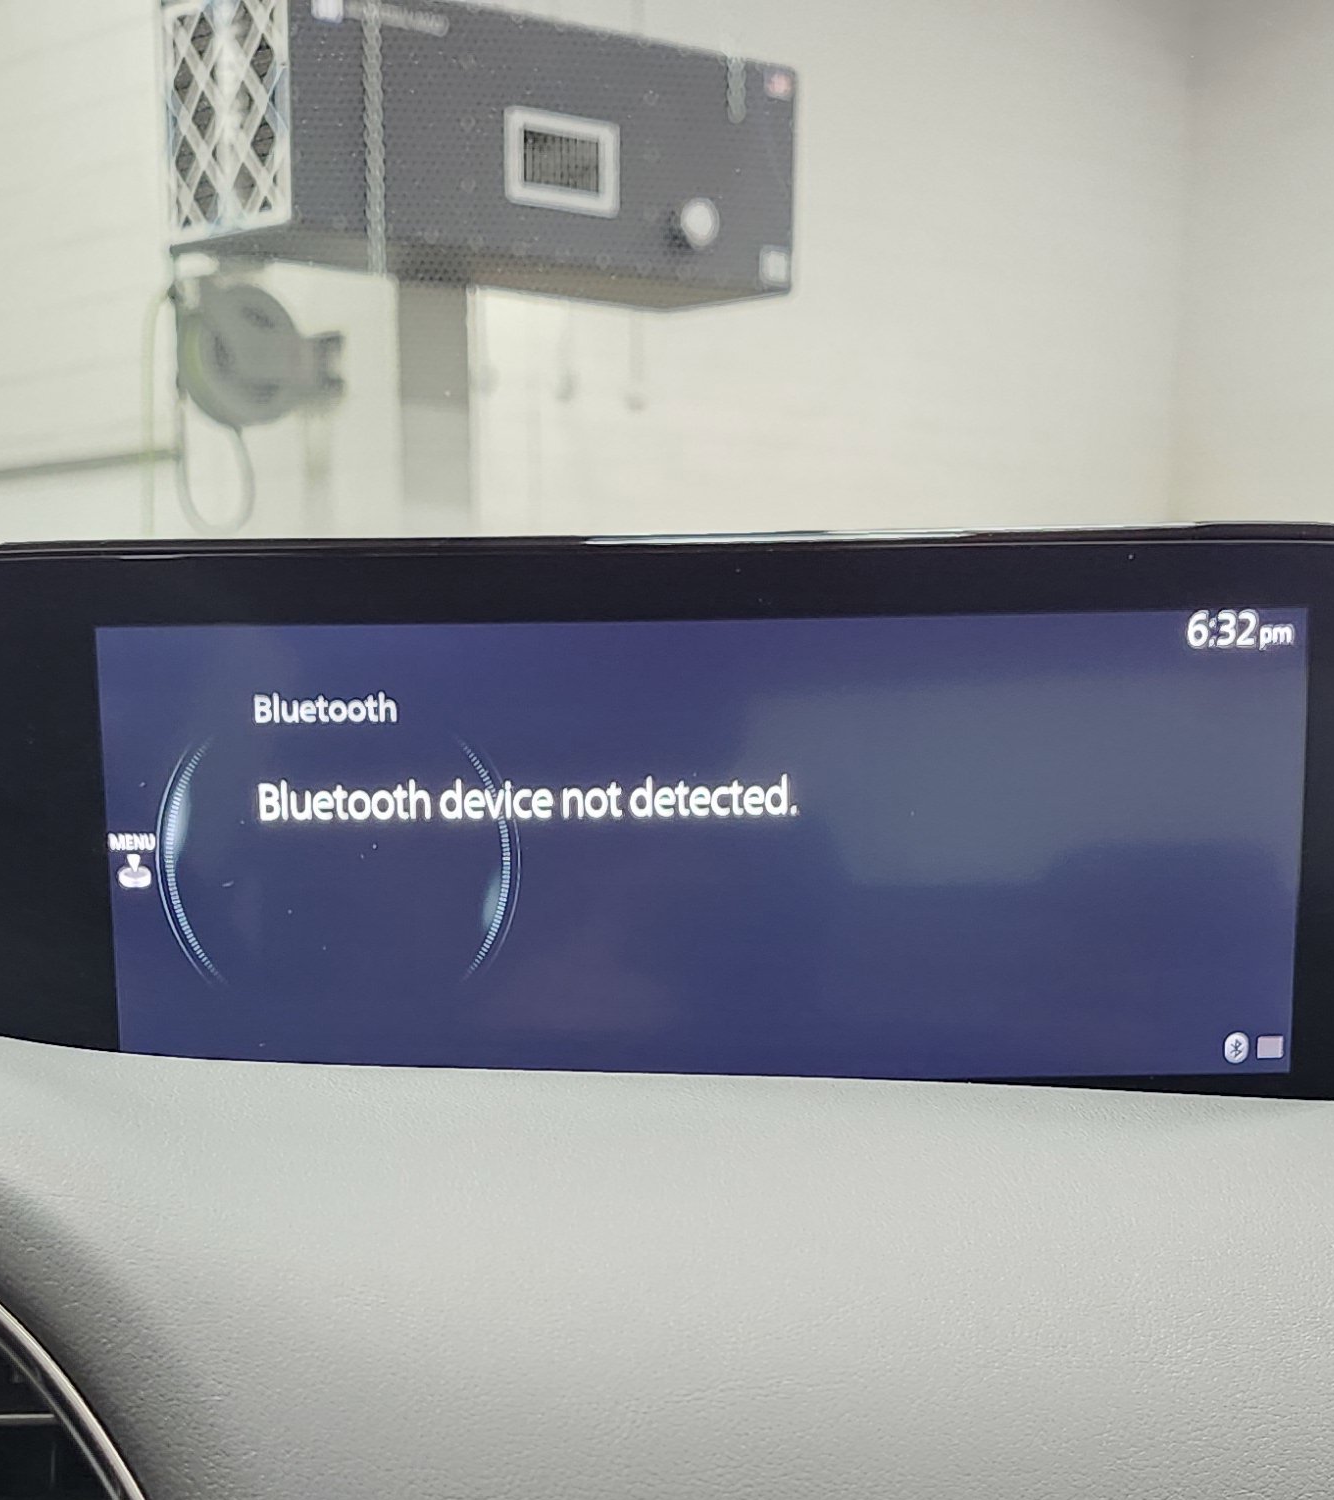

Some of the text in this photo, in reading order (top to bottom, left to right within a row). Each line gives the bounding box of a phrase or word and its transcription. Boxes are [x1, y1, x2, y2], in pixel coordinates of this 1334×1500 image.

[253, 691, 398, 725] Bluetooth
[257, 773, 799, 823] Bluetooth device not detected.
[108, 832, 156, 852] MENU
